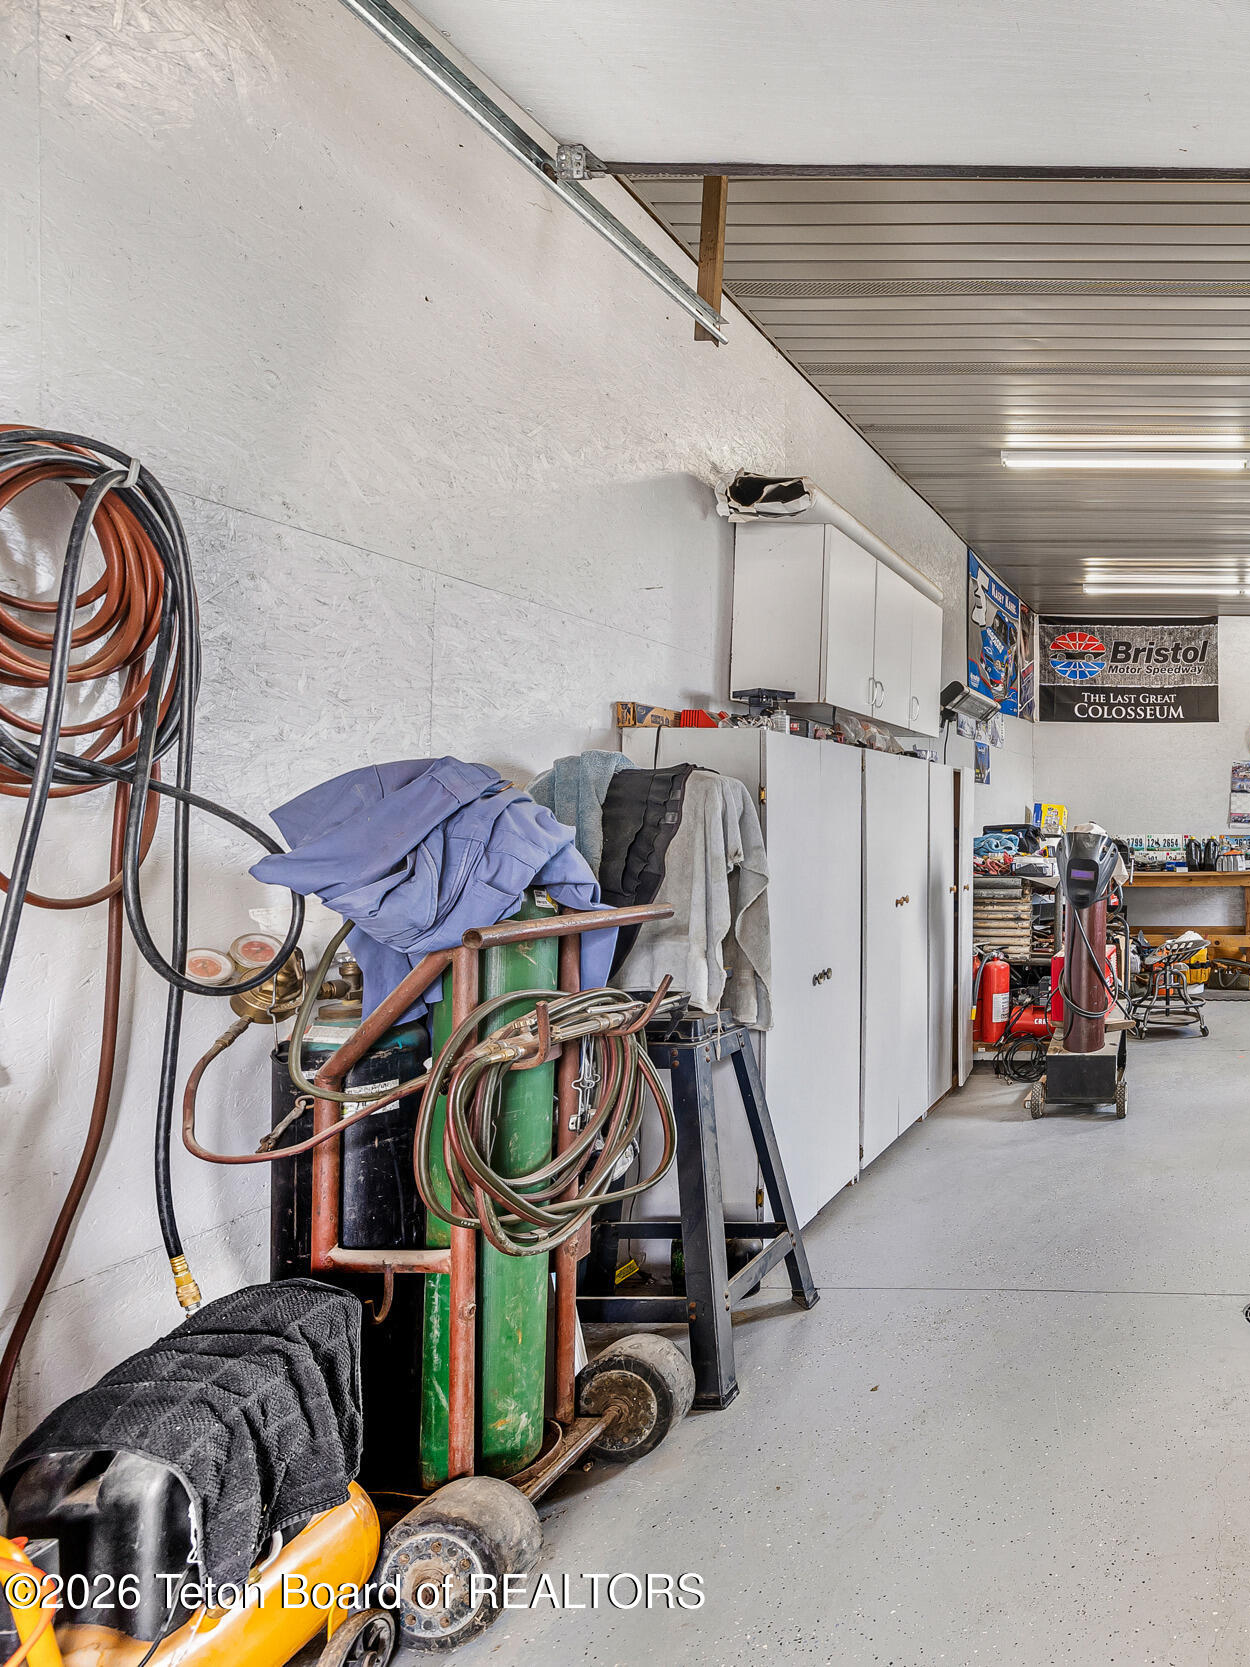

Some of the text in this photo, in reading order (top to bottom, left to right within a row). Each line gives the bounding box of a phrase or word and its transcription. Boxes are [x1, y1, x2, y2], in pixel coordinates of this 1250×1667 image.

[1110, 640, 1208, 665] Bristol
[1107, 665, 1204, 676] Motor Speedway
[1081, 692, 1177, 703] THE LAST GREAT
[1074, 703, 1185, 719] COLOSSEUM
[1163, 838, 1179, 848] 2654
